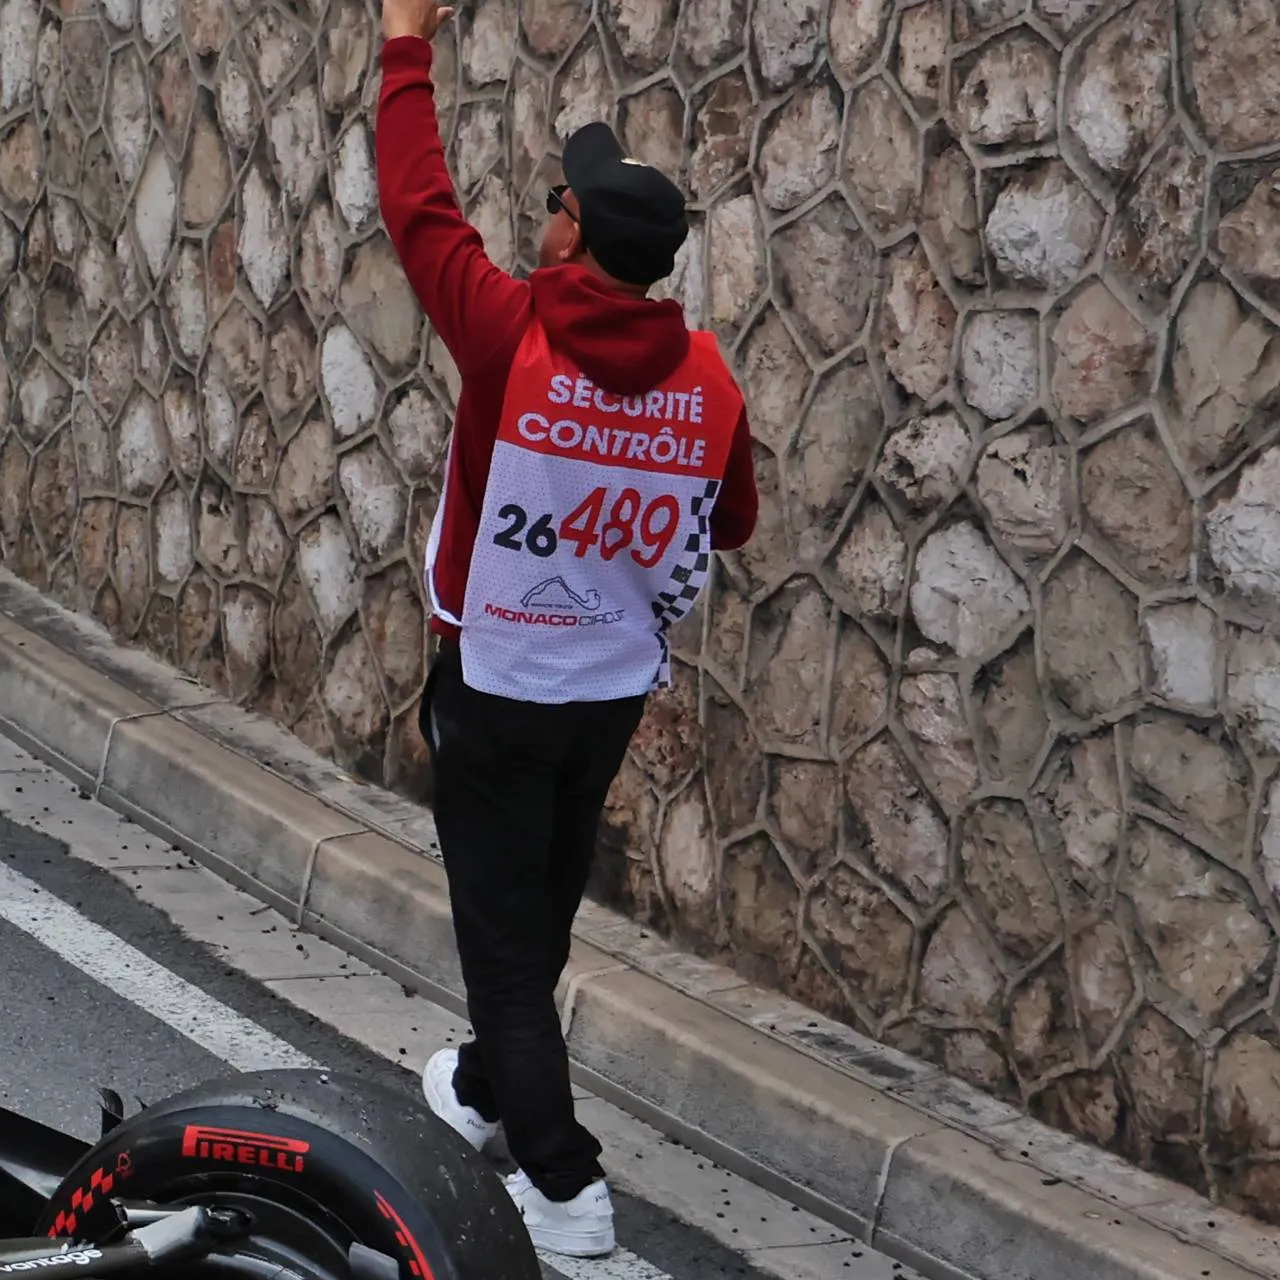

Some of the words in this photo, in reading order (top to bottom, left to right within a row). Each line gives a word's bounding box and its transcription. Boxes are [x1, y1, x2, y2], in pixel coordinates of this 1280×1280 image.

[548, 373, 704, 423] SÉCURITÉ
[517, 412, 706, 467] CONTRÔLE
[493, 503, 558, 558] 26
[559, 487, 680, 568] 489
[182, 1124, 311, 1173] PIRELLI
